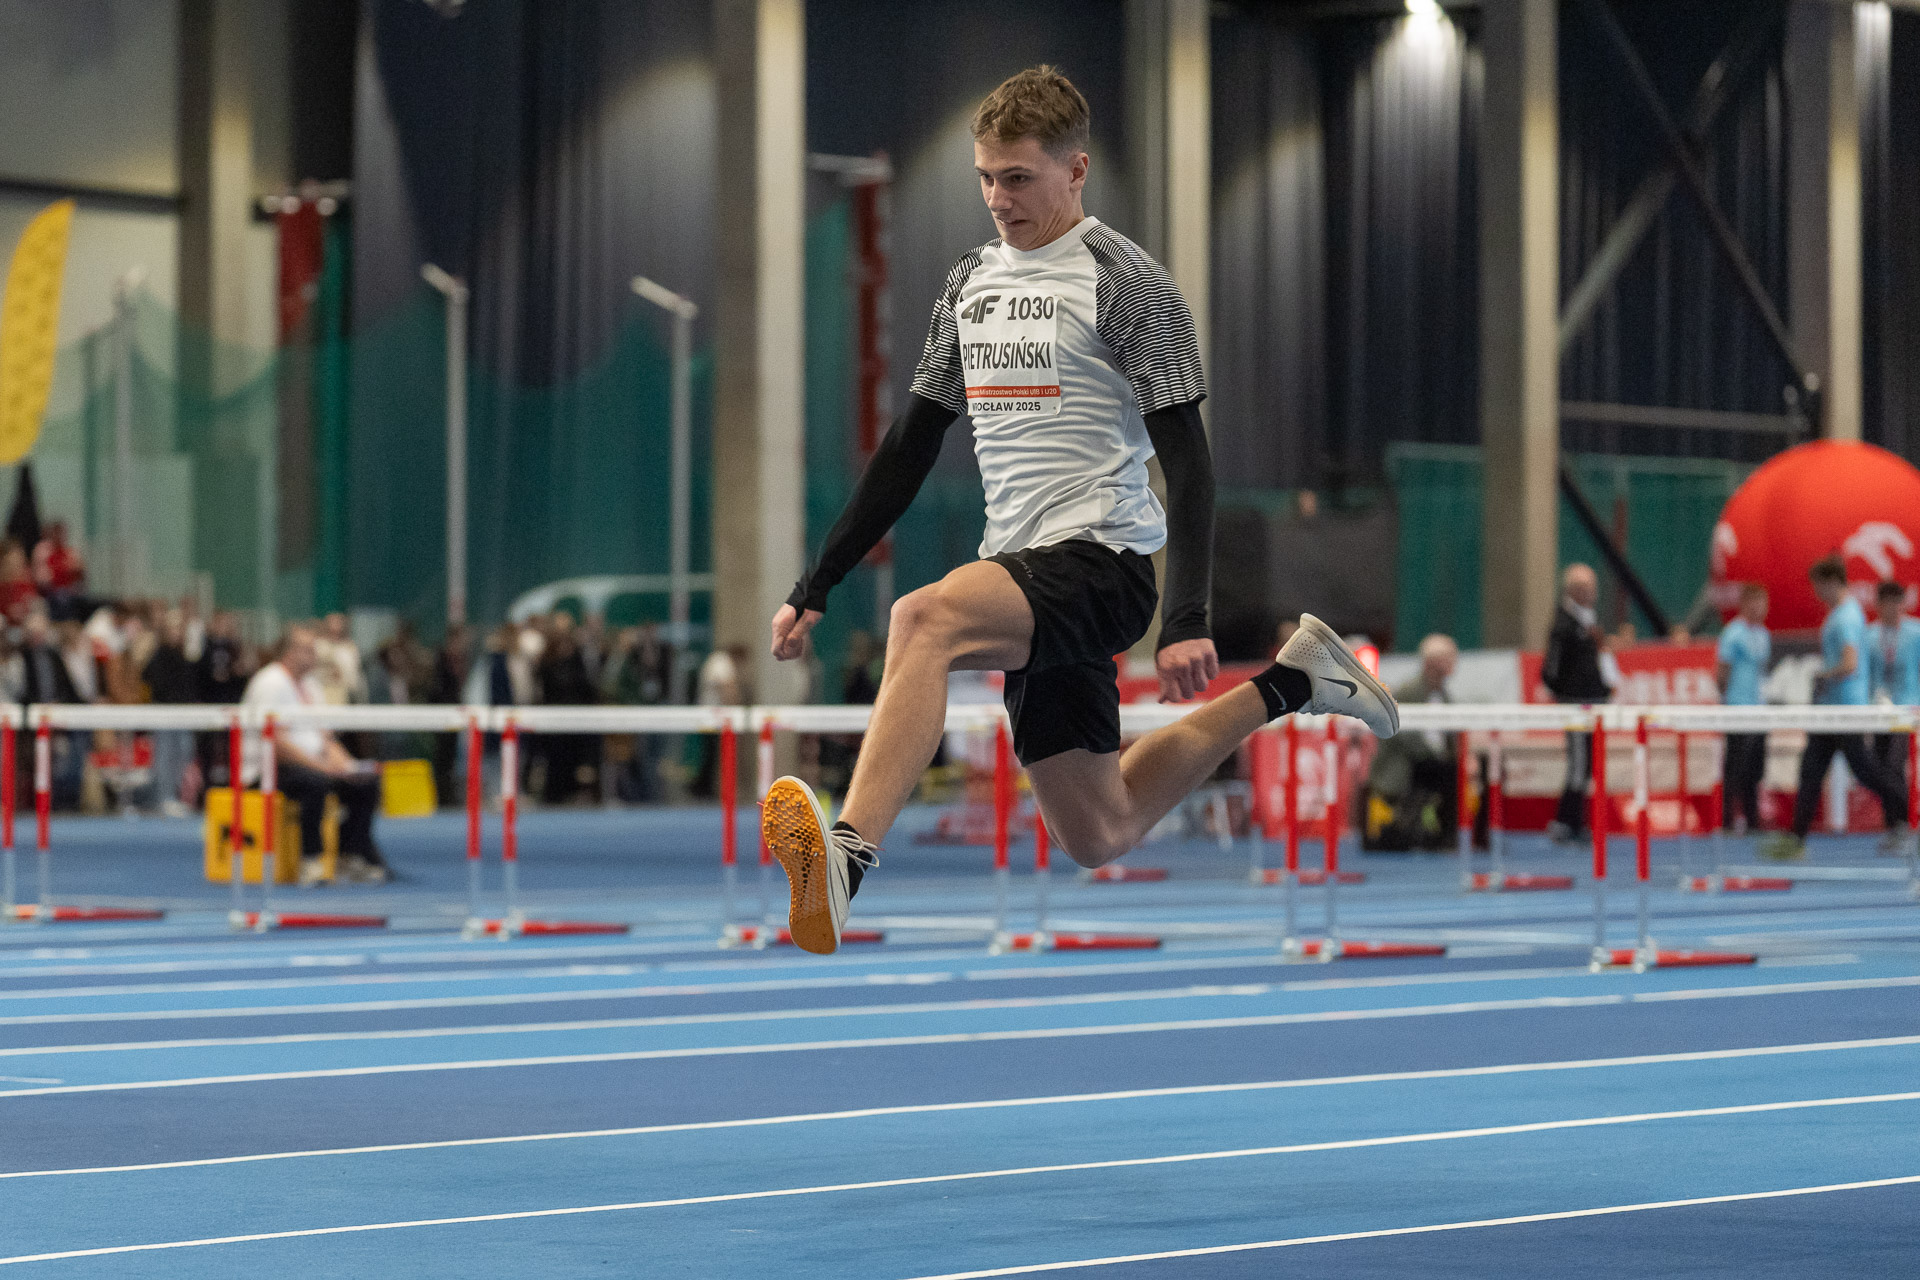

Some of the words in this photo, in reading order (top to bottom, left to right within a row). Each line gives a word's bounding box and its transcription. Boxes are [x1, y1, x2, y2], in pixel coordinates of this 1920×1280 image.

[961, 295, 1001, 324] 4F
[1007, 296, 1054, 321] 1030
[963, 336, 1052, 370] PIETRUSIŃSKI
[979, 388, 1012, 396] Mistrzostwa
[1045, 387, 1057, 395] U20
[1016, 401, 1041, 411] 2025
